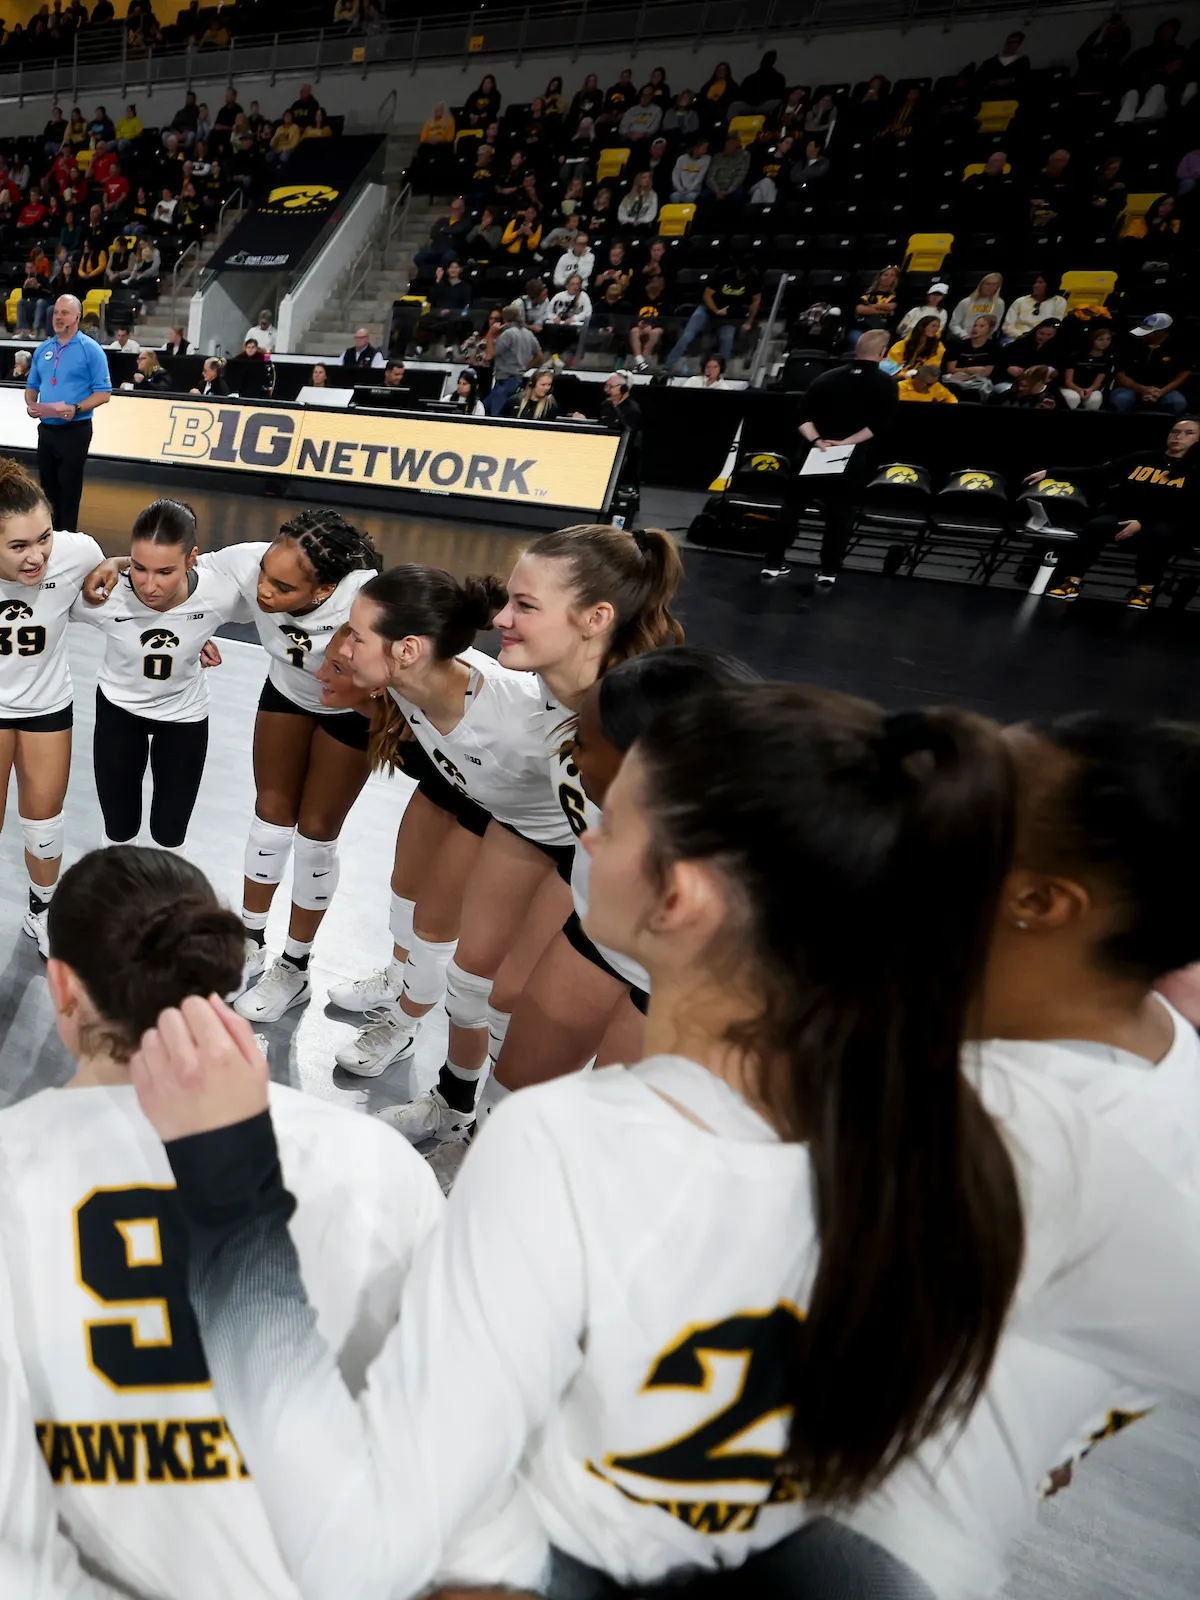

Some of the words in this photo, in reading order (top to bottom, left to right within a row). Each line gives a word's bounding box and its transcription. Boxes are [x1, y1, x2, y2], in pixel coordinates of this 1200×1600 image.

[297, 438, 538, 496] NETWORK
[1127, 466, 1185, 488] IOWA
[143, 653, 174, 681] 0
[73, 1184, 213, 1393] 9
